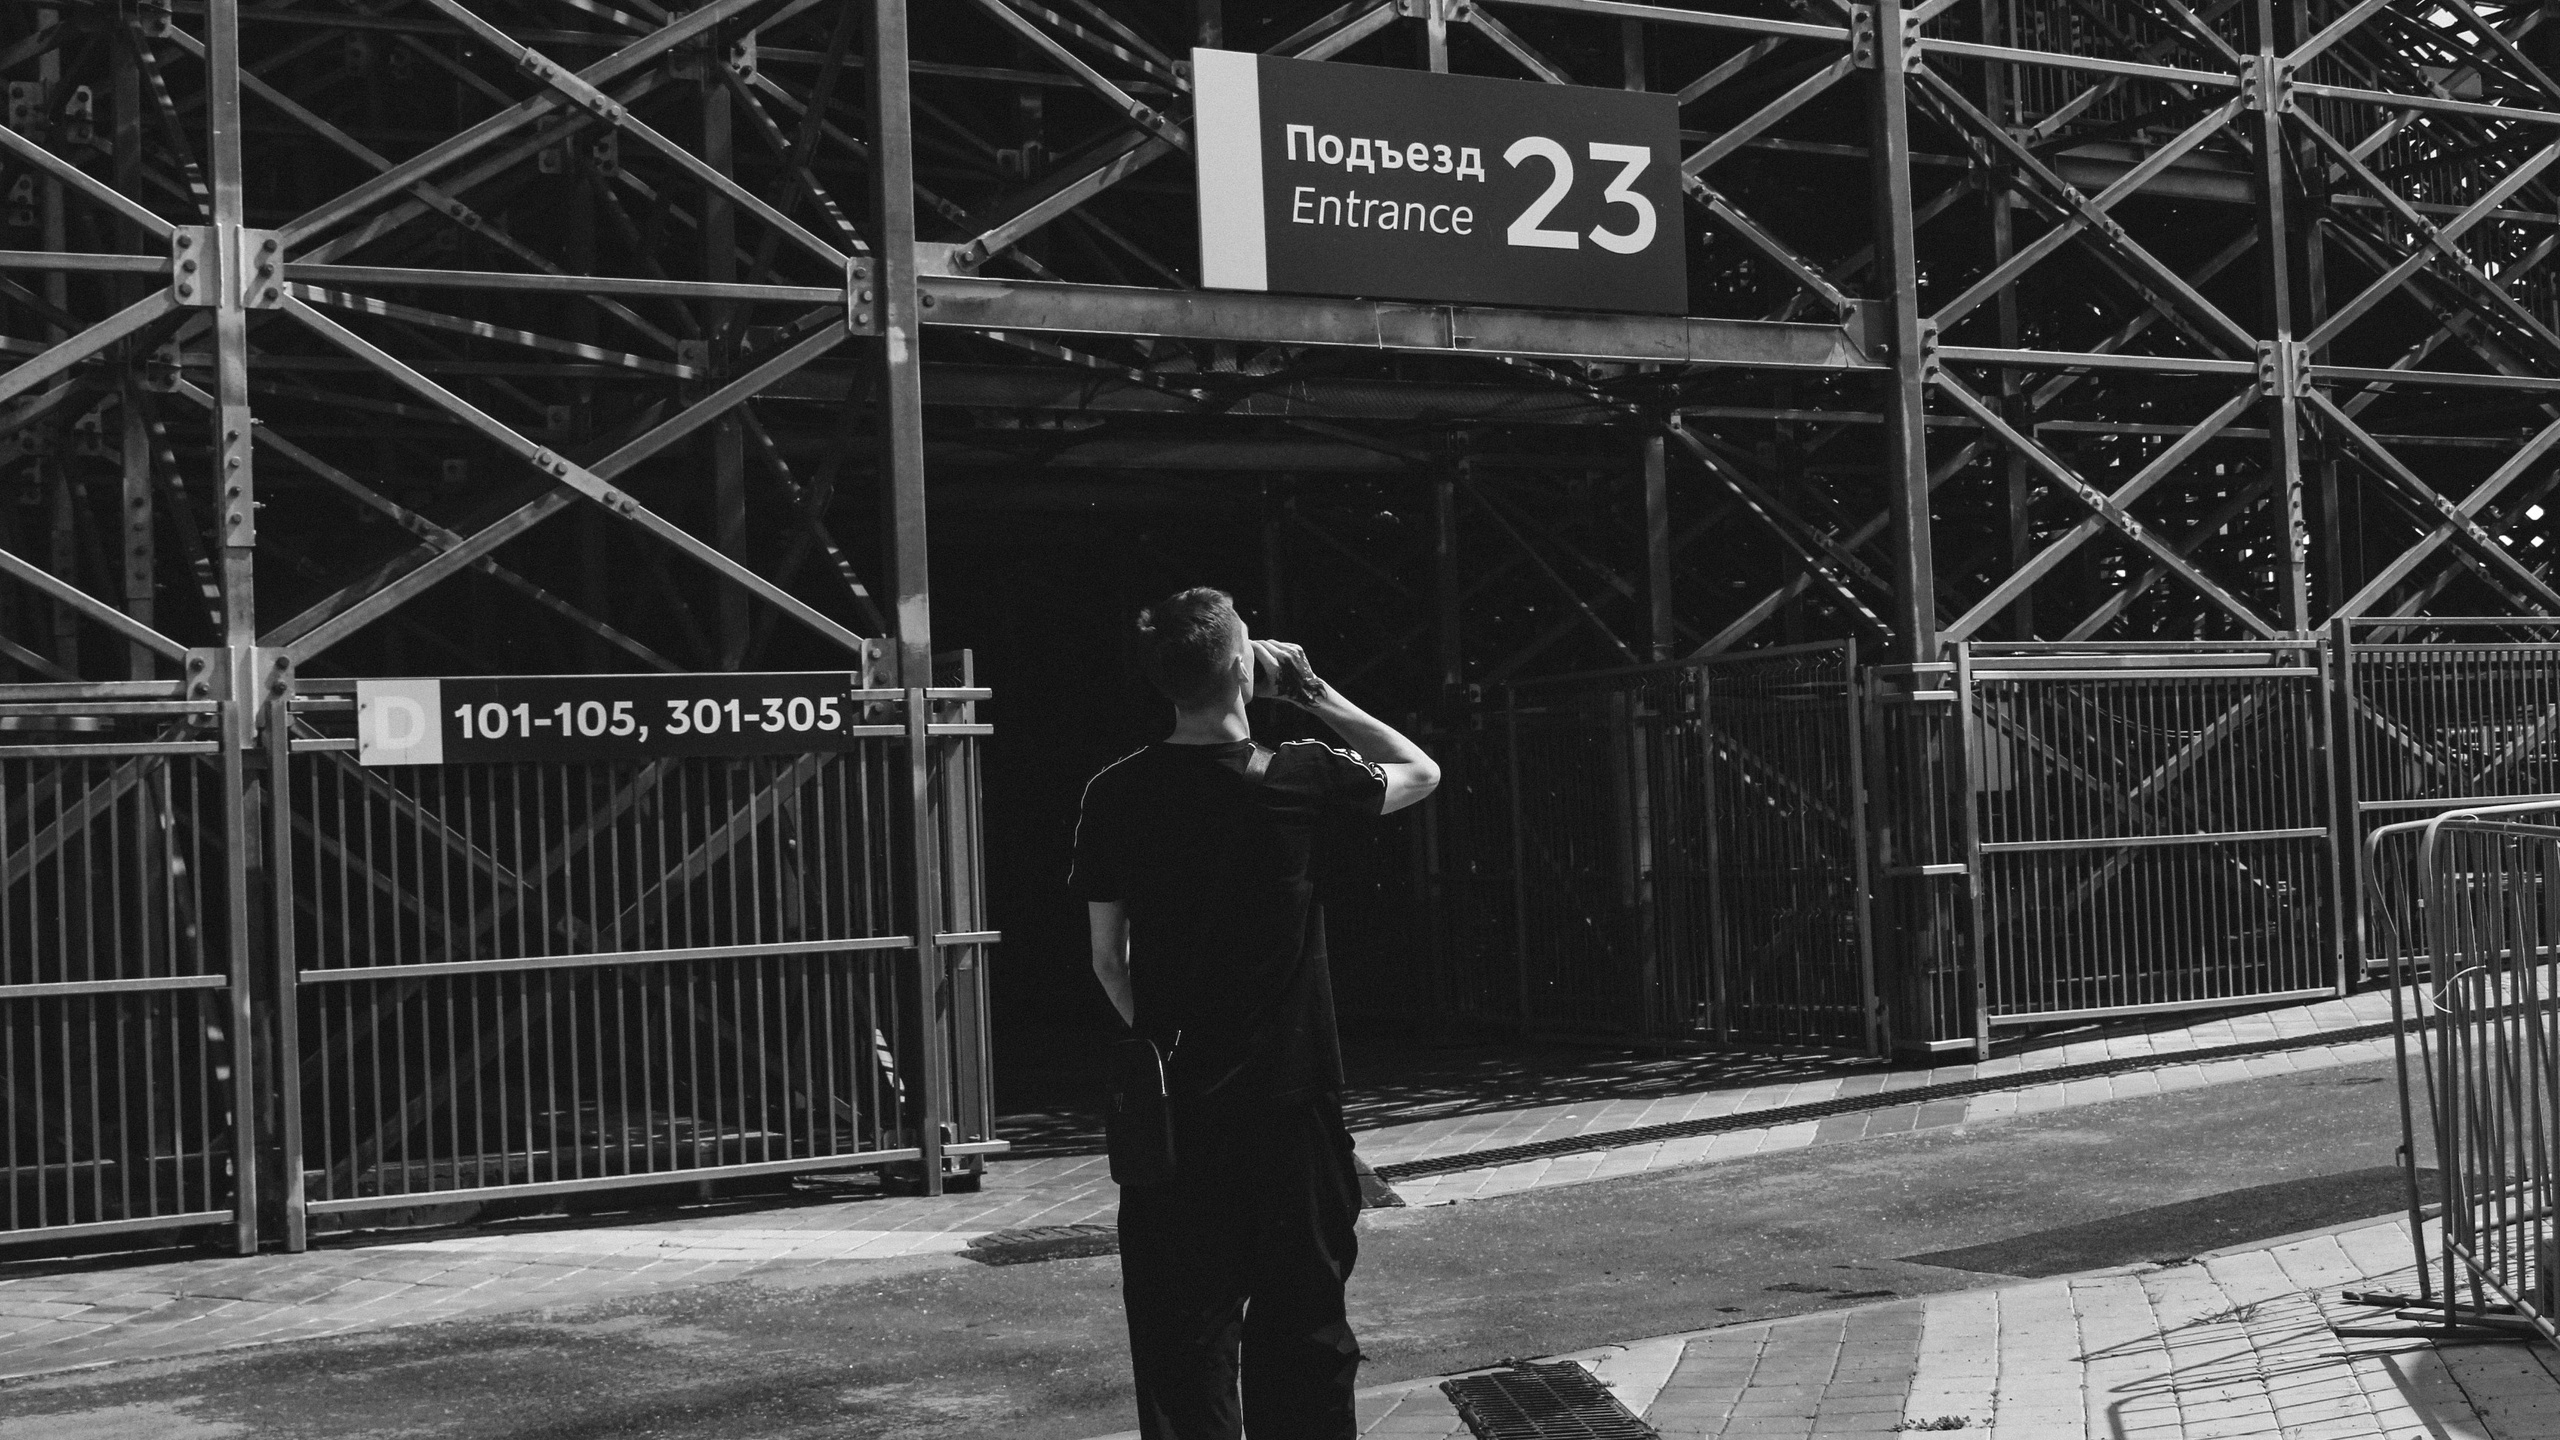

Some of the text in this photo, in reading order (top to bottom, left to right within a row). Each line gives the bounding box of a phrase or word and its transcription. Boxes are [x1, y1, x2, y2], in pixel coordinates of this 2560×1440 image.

[1286, 123, 1486, 183] Подъезд
[1291, 185, 1474, 236] Entrance
[1502, 135, 1657, 255] 23
[375, 696, 842, 750] D 101-105, 301-305
